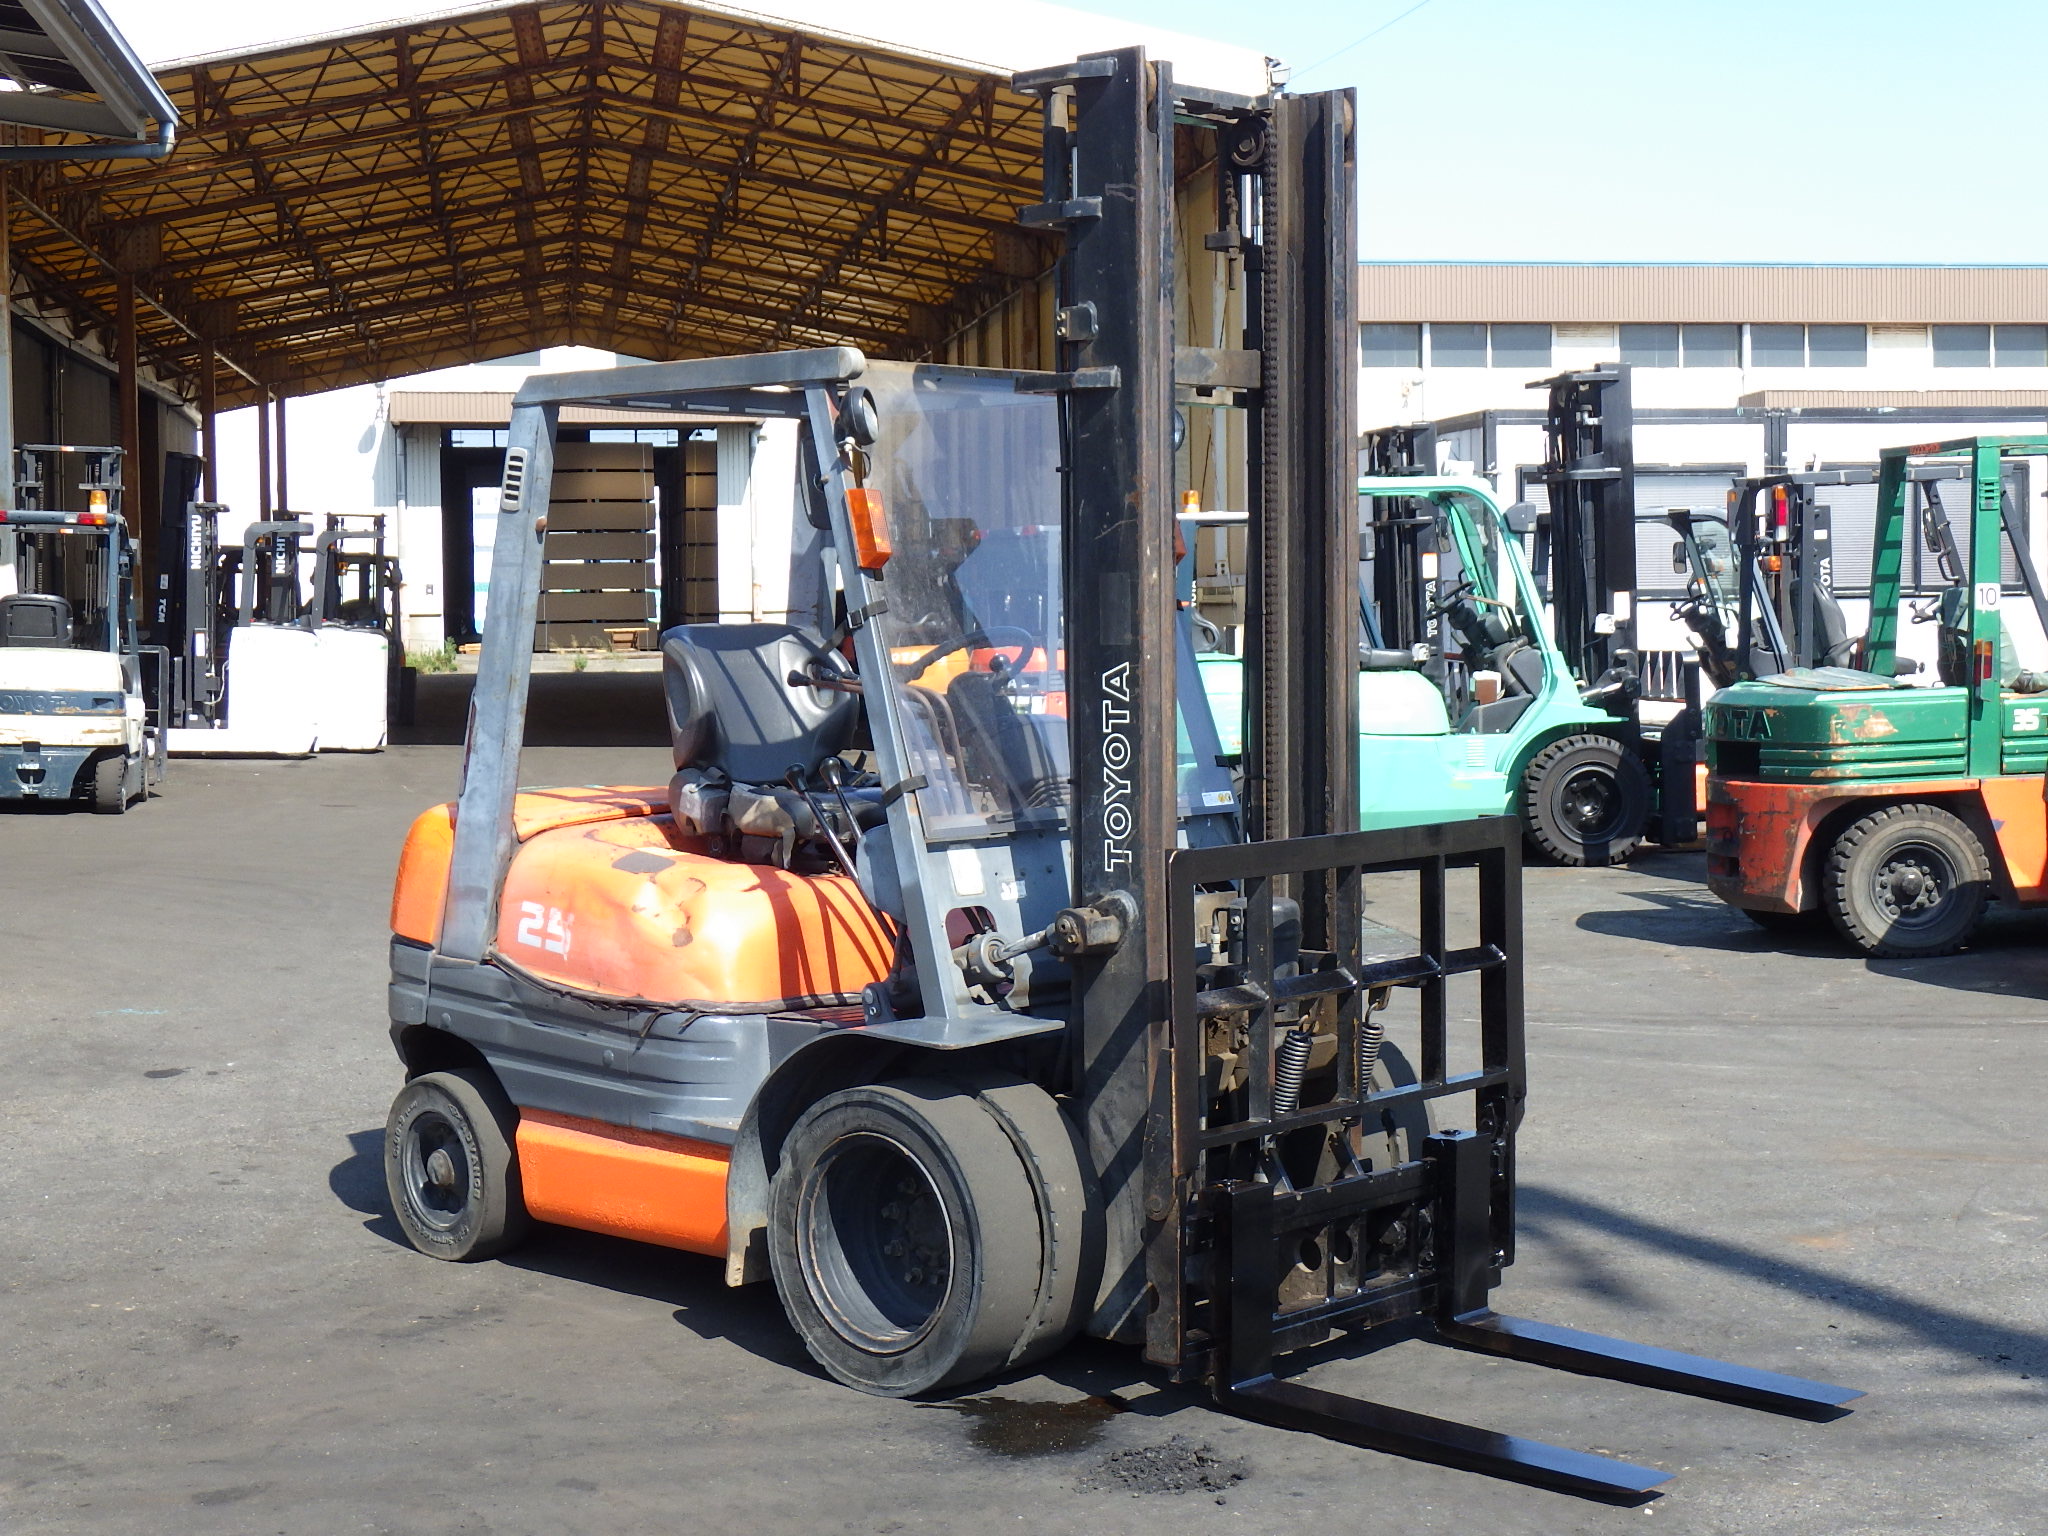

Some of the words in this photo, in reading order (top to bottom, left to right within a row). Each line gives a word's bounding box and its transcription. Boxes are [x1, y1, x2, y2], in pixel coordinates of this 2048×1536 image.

[190, 514, 202, 570] NICHIYU
[1819, 557, 1832, 592] OTA
[1979, 587, 1997, 606] 10
[1425, 581, 1438, 638] TOOTA
[2012, 707, 2040, 731] 35
[1102, 661, 1133, 873] TOYOTA
[517, 900, 572, 957] 25
